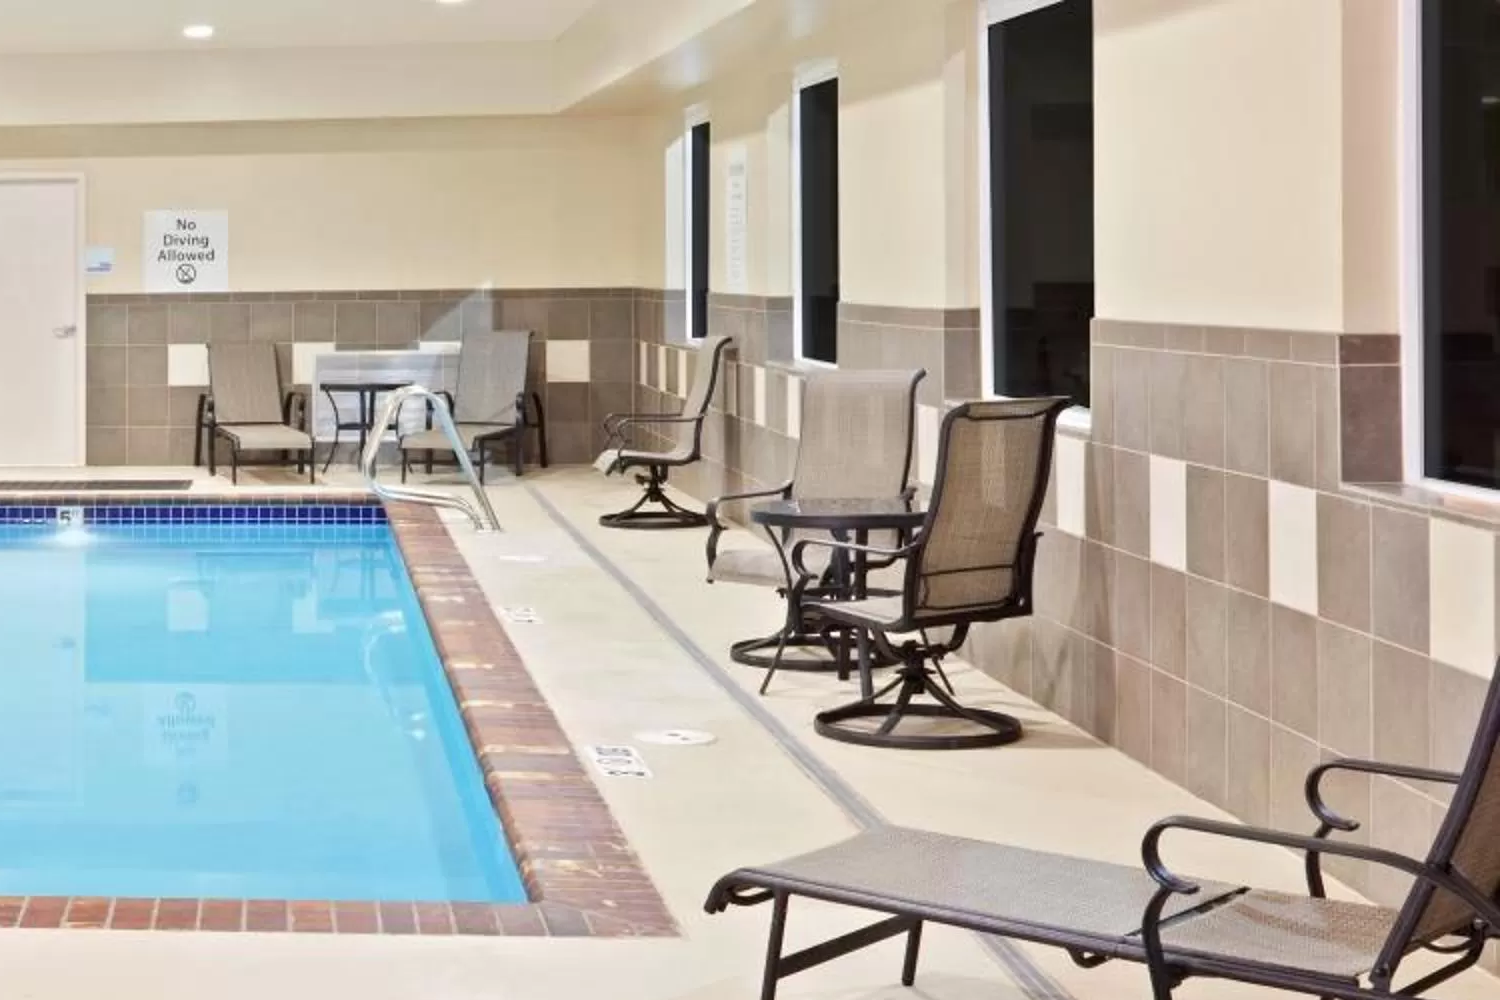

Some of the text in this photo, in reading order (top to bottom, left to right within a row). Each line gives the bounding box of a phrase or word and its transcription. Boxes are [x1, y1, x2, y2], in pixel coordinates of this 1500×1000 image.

[176, 218, 197, 231] No
[163, 233, 209, 249] Diving
[157, 249, 215, 262] Allowed
